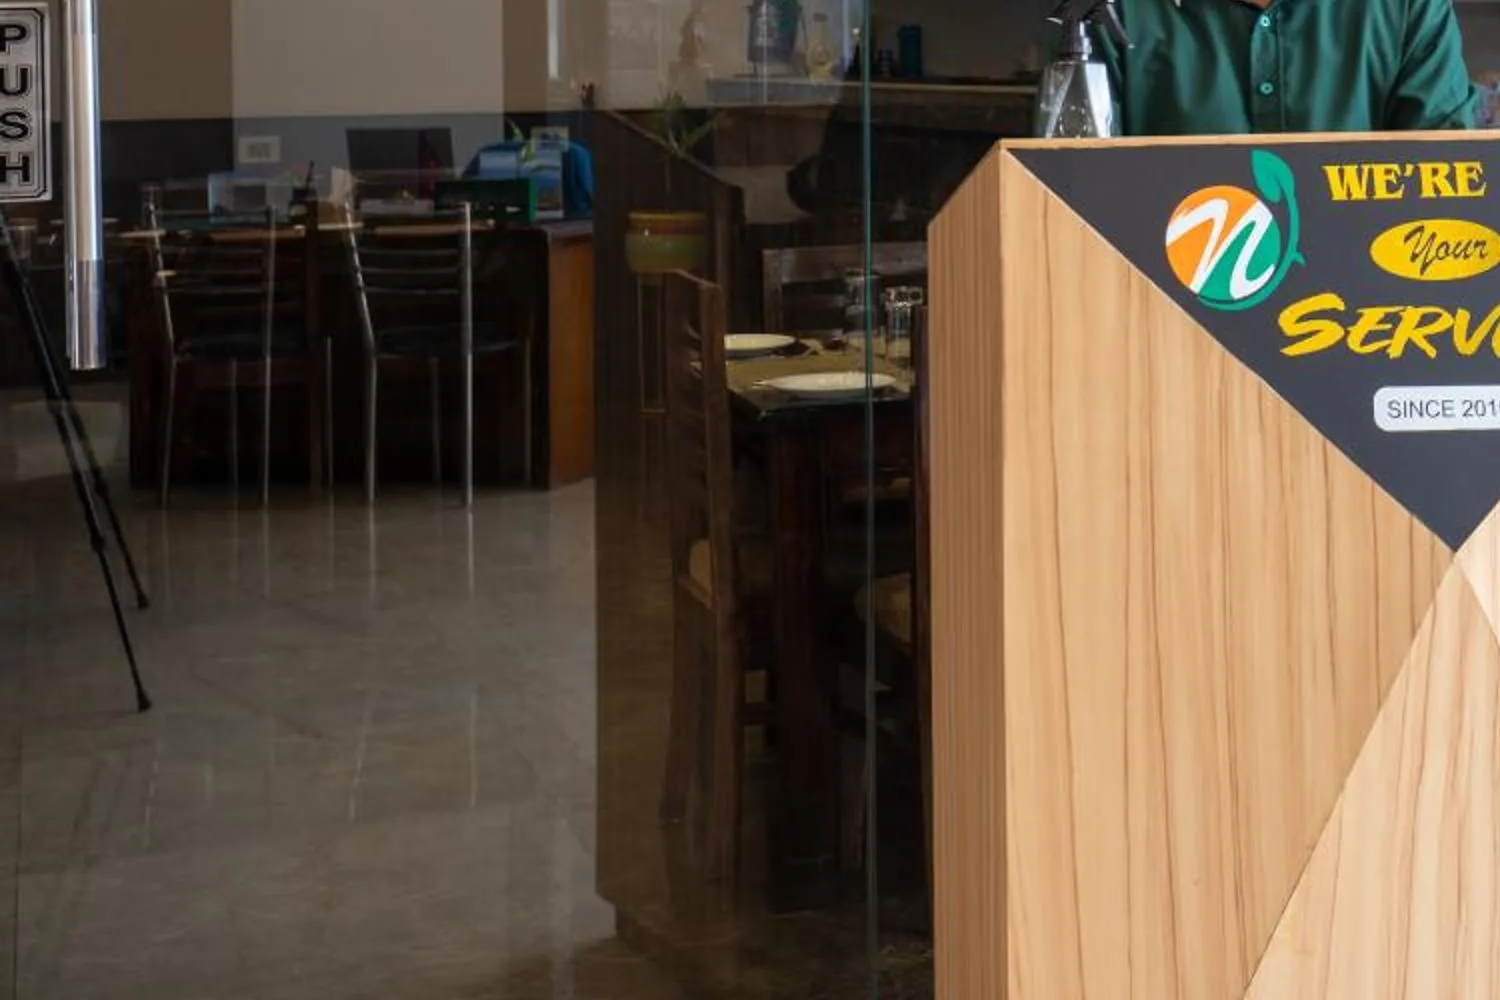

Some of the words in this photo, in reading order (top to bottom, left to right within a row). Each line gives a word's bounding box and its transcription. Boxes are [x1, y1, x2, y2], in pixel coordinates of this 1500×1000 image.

[0, 23, 30, 183] PUSH
[1321, 160, 1486, 201] WE'RE
[1403, 223, 1490, 276] Your
[1387, 399, 1456, 420] SINCE
